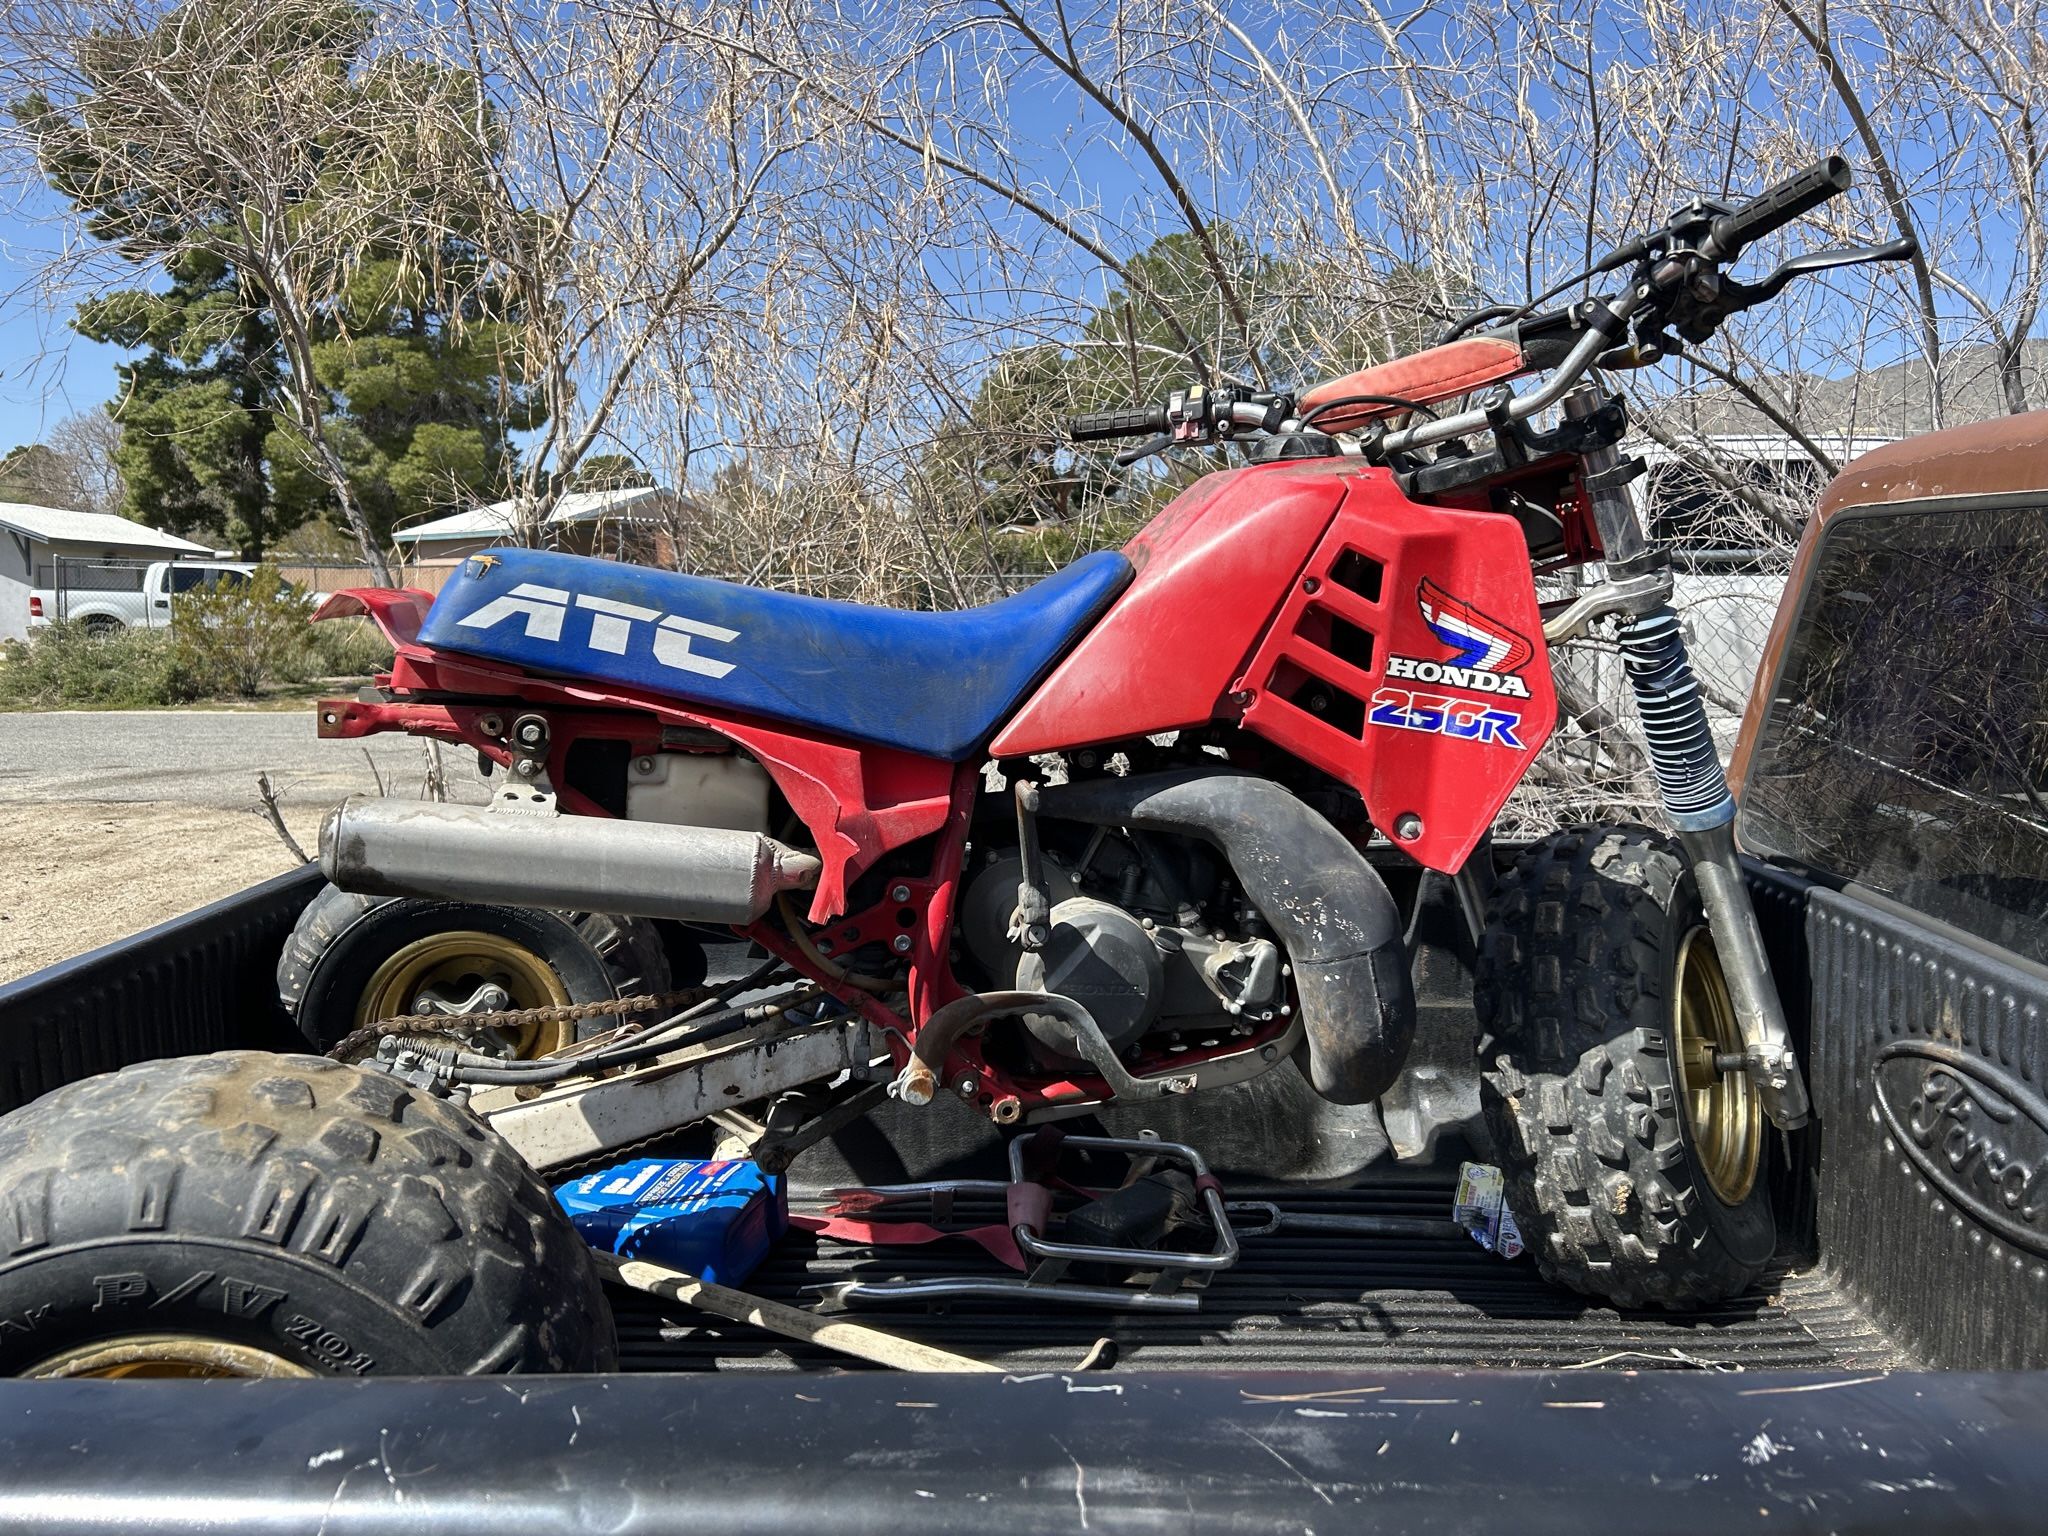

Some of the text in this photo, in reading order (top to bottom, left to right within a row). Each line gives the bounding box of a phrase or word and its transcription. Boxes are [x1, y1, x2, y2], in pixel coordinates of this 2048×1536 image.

[456, 582, 742, 679] ATC
[1387, 656, 1531, 698] HONDA
[1368, 688, 1528, 750] 250R
[92, 1270, 289, 1319] P/V
[284, 1314, 377, 1376] 701
